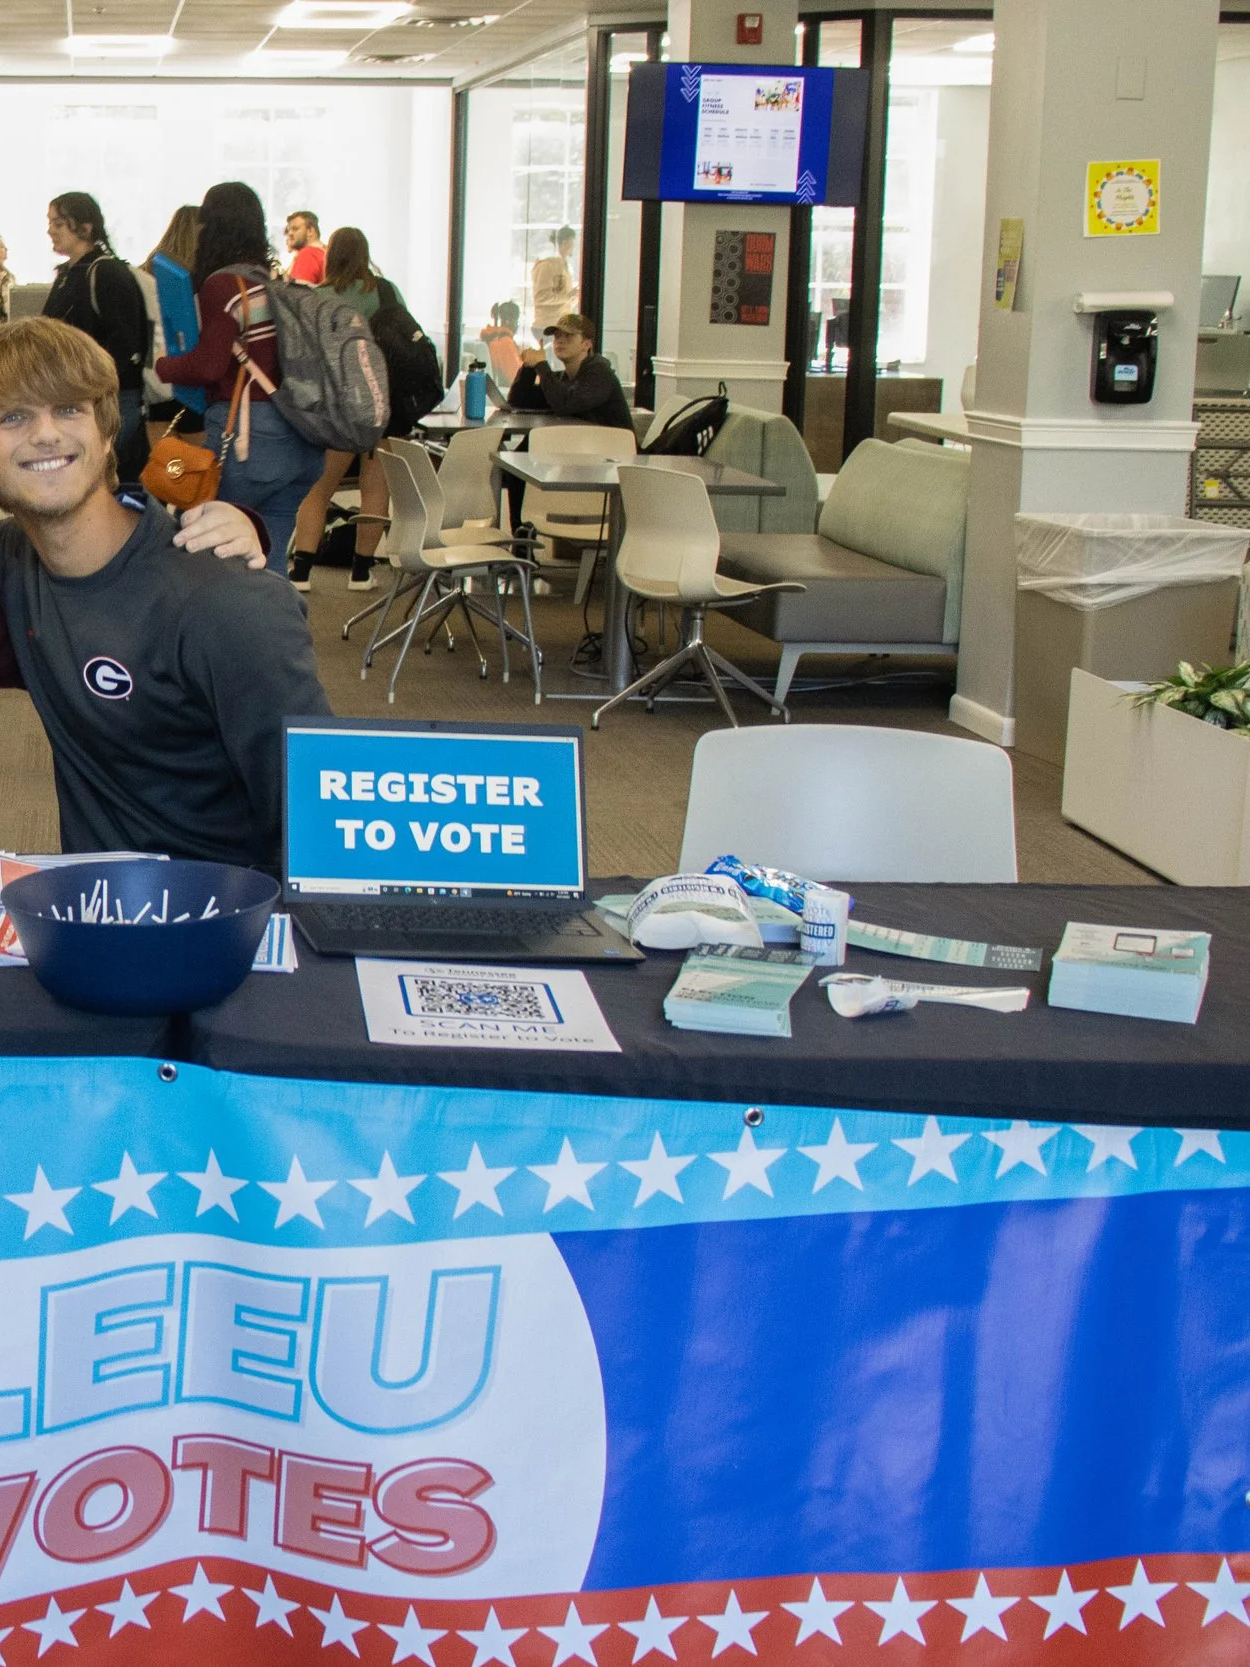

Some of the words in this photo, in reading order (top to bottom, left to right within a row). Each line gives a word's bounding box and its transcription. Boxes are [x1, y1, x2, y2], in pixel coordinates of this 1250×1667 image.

[83, 656, 133, 699] G
[319, 770, 543, 807] REGISTER
[336, 819, 396, 851] TO
[409, 822, 525, 855] VOTE
[390, 1028, 416, 1036] To
[423, 1030, 508, 1041] Register
[545, 1035, 595, 1043] Vote
[420, 1020, 500, 1032] SCAN
[512, 1024, 556, 1034] ME
